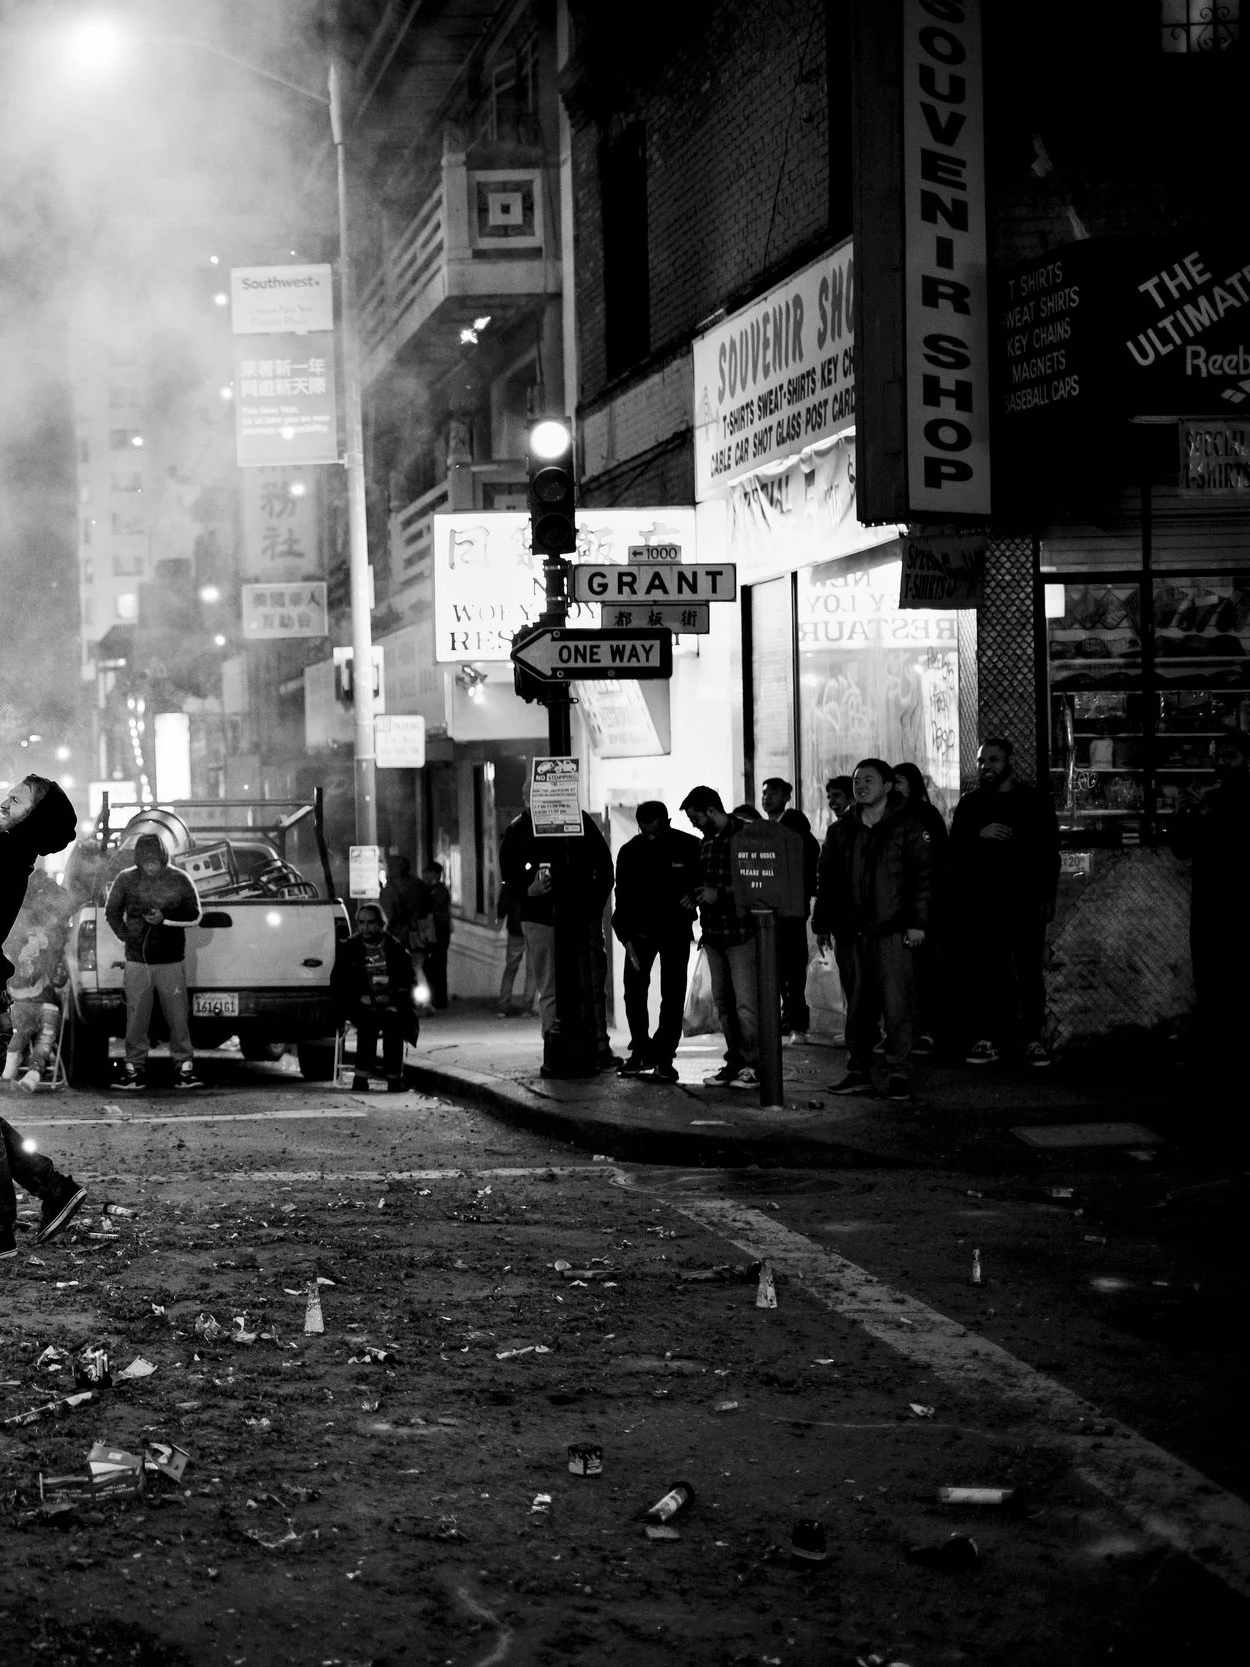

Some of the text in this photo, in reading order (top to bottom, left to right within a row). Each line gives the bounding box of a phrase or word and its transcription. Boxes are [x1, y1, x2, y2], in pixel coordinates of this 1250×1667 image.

[917, 0, 974, 490] SOUVENIR SHOP
[242, 276, 314, 290] Southwest
[1020, 261, 1063, 296] SHIRTS
[1137, 250, 1213, 310] THE
[1040, 286, 1081, 319] SHIRTS
[718, 258, 854, 405] SOUVENIR SHO
[1006, 317, 1072, 358] KEY CHAINS
[1012, 349, 1067, 384] MAGNETS
[722, 398, 755, 440] T-SHIRTS
[820, 354, 839, 390] KEY
[1051, 375, 1080, 405] CAPS
[735, 440, 750, 468] CAR
[752, 425, 773, 460] SHOT
[776, 412, 801, 448] GLASS
[805, 398, 829, 435] POST
[832, 385, 856, 423] CARD
[646, 548, 678, 560] 1000
[587, 571, 724, 595] GRANT
[613, 609, 698, 627] 都板街
[558, 643, 655, 664] ONE WAY
